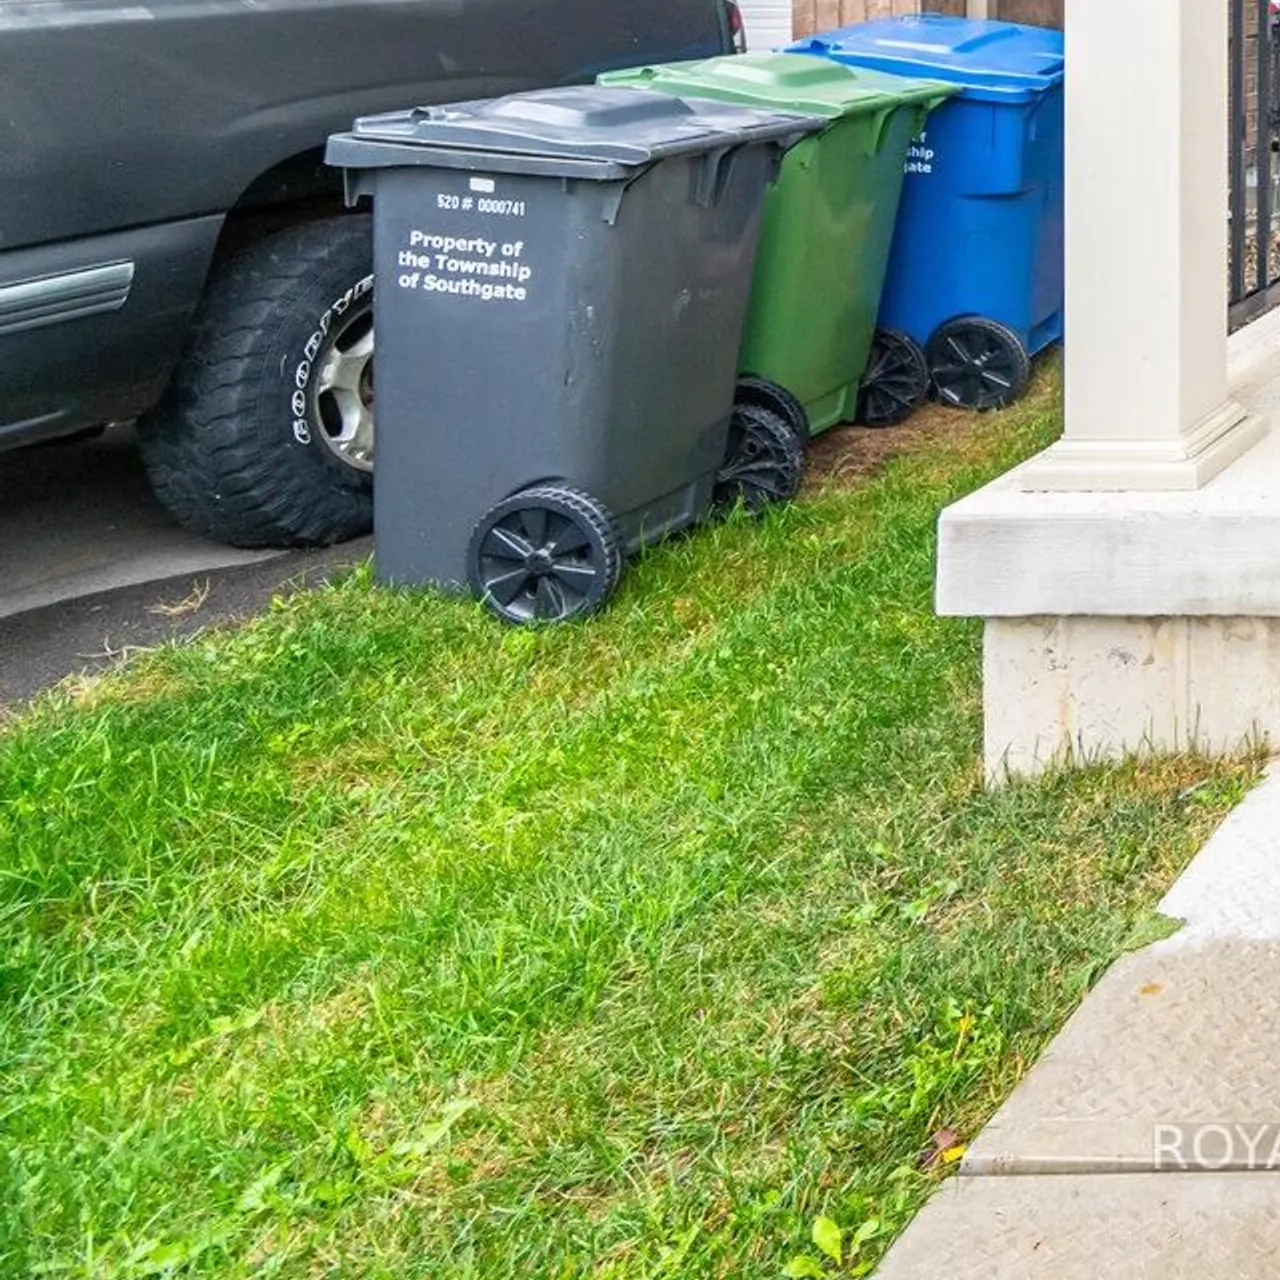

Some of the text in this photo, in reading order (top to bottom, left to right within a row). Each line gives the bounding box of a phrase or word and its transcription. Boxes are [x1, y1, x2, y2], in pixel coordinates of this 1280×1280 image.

[410, 230, 524, 257] Property of
[398, 251, 531, 282] the Township
[398, 272, 527, 300] of Southgate
